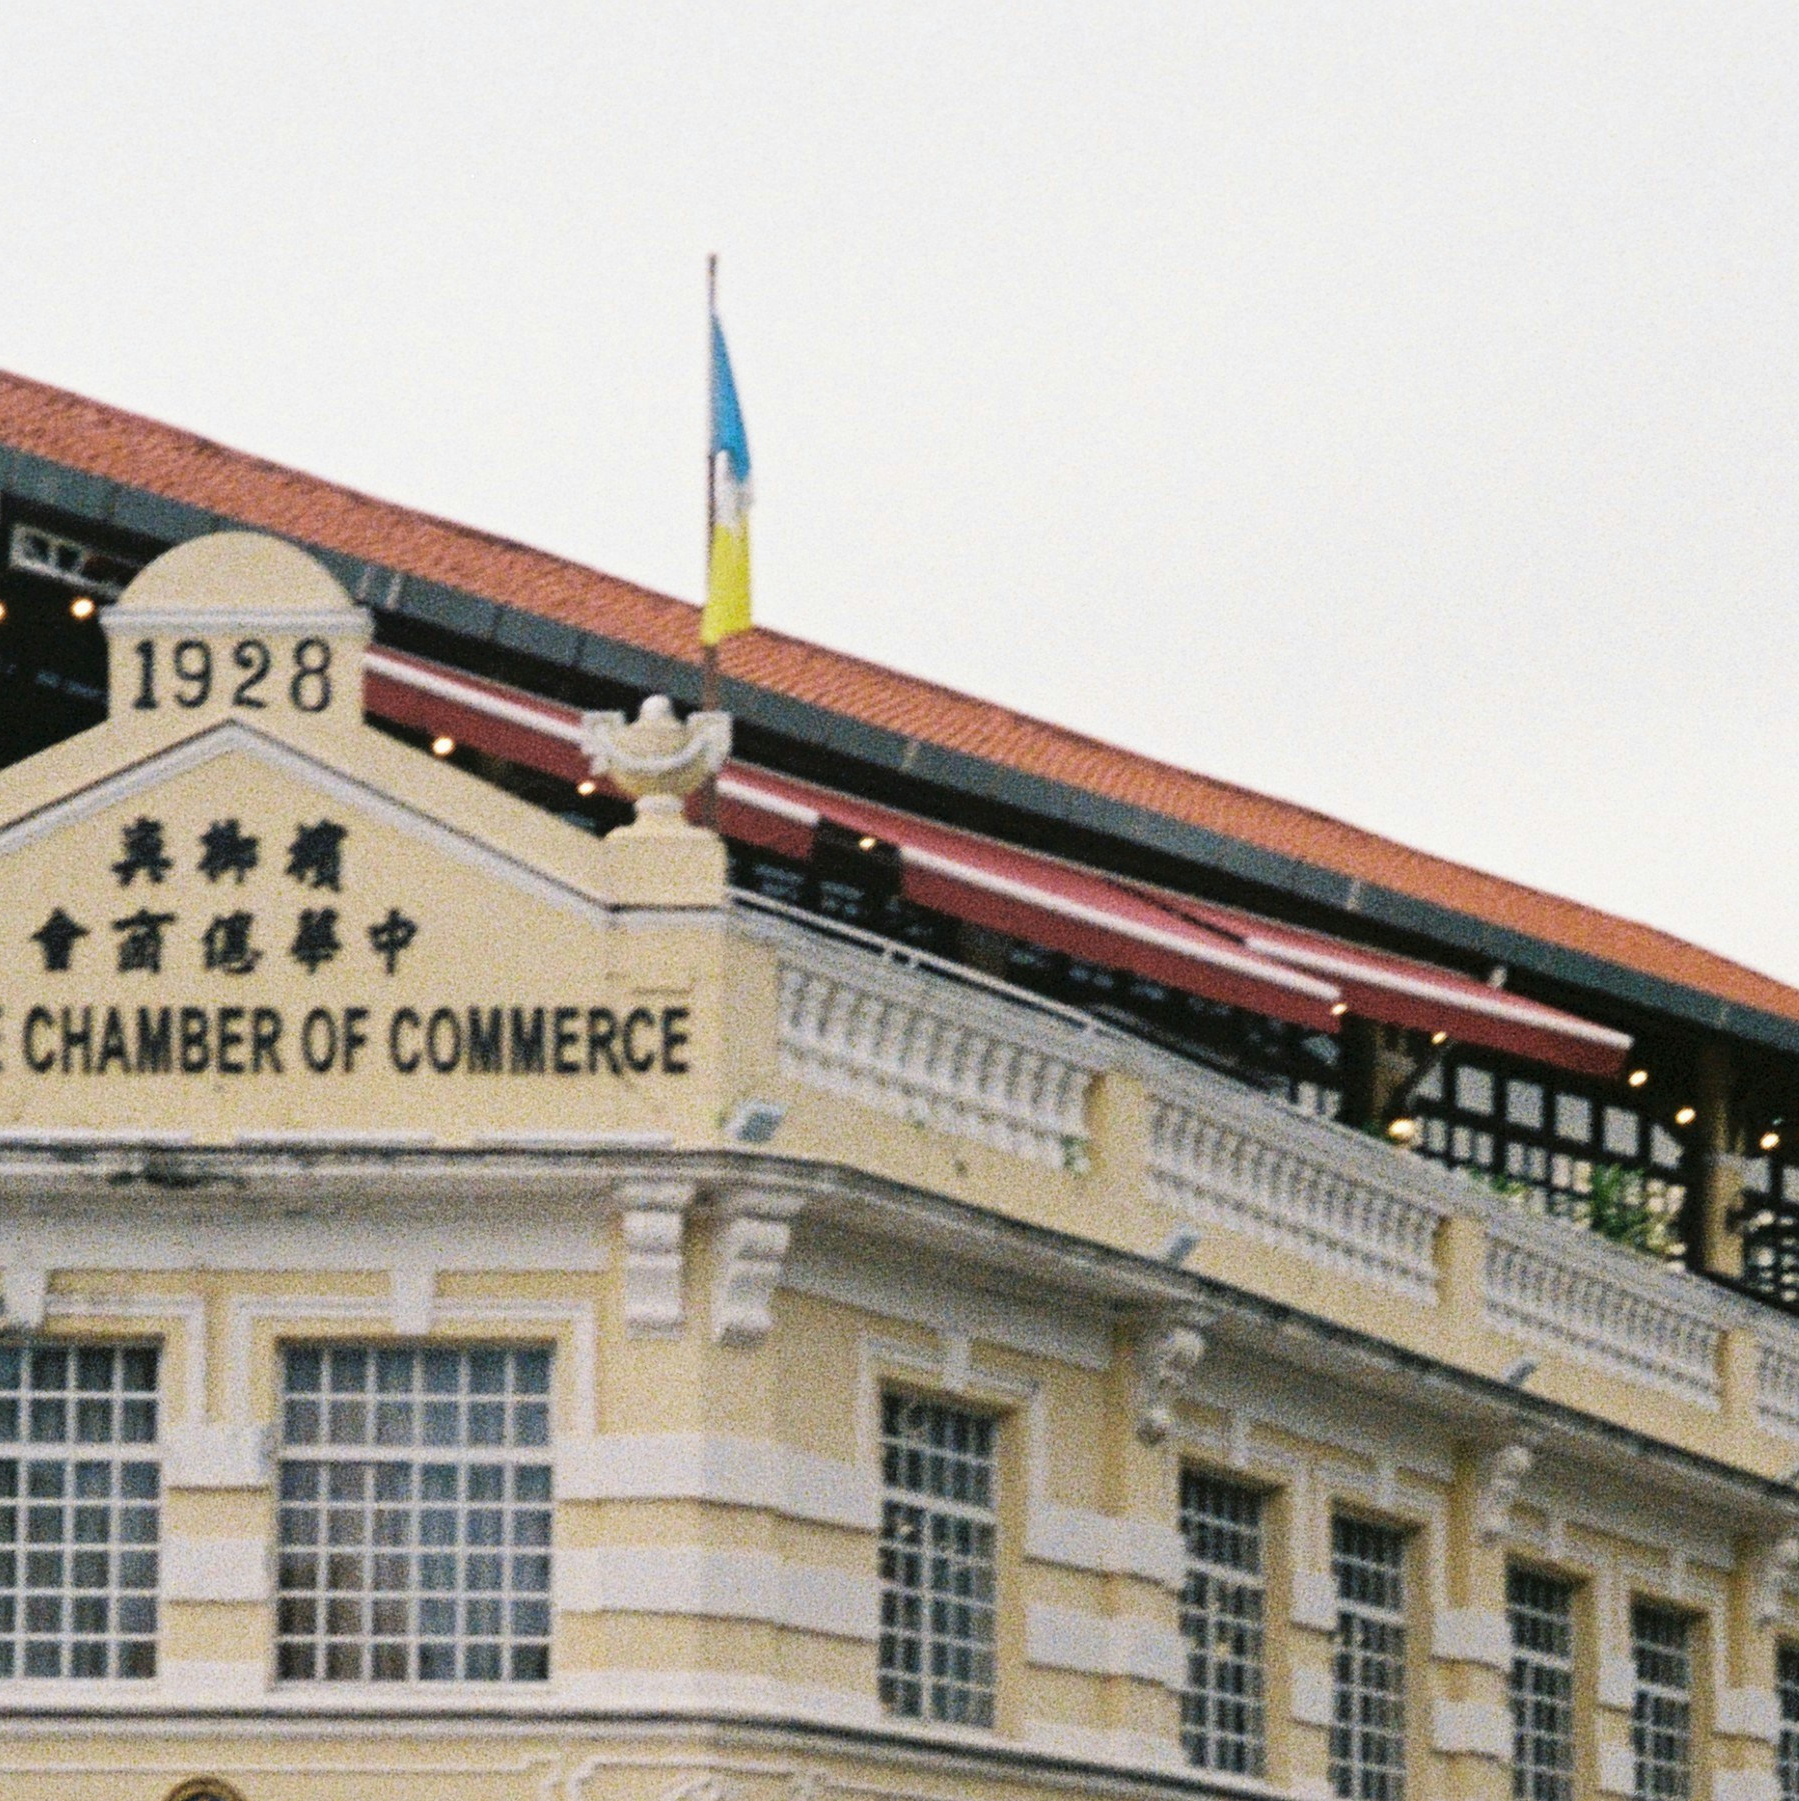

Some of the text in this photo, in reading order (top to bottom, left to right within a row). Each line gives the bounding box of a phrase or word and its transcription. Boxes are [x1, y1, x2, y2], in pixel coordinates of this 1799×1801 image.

[133, 637, 334, 713] 1928
[23, 1004, 284, 1075] CHAMBER
[301, 1005, 370, 1075] OF
[389, 1005, 691, 1077] COMMERCE
